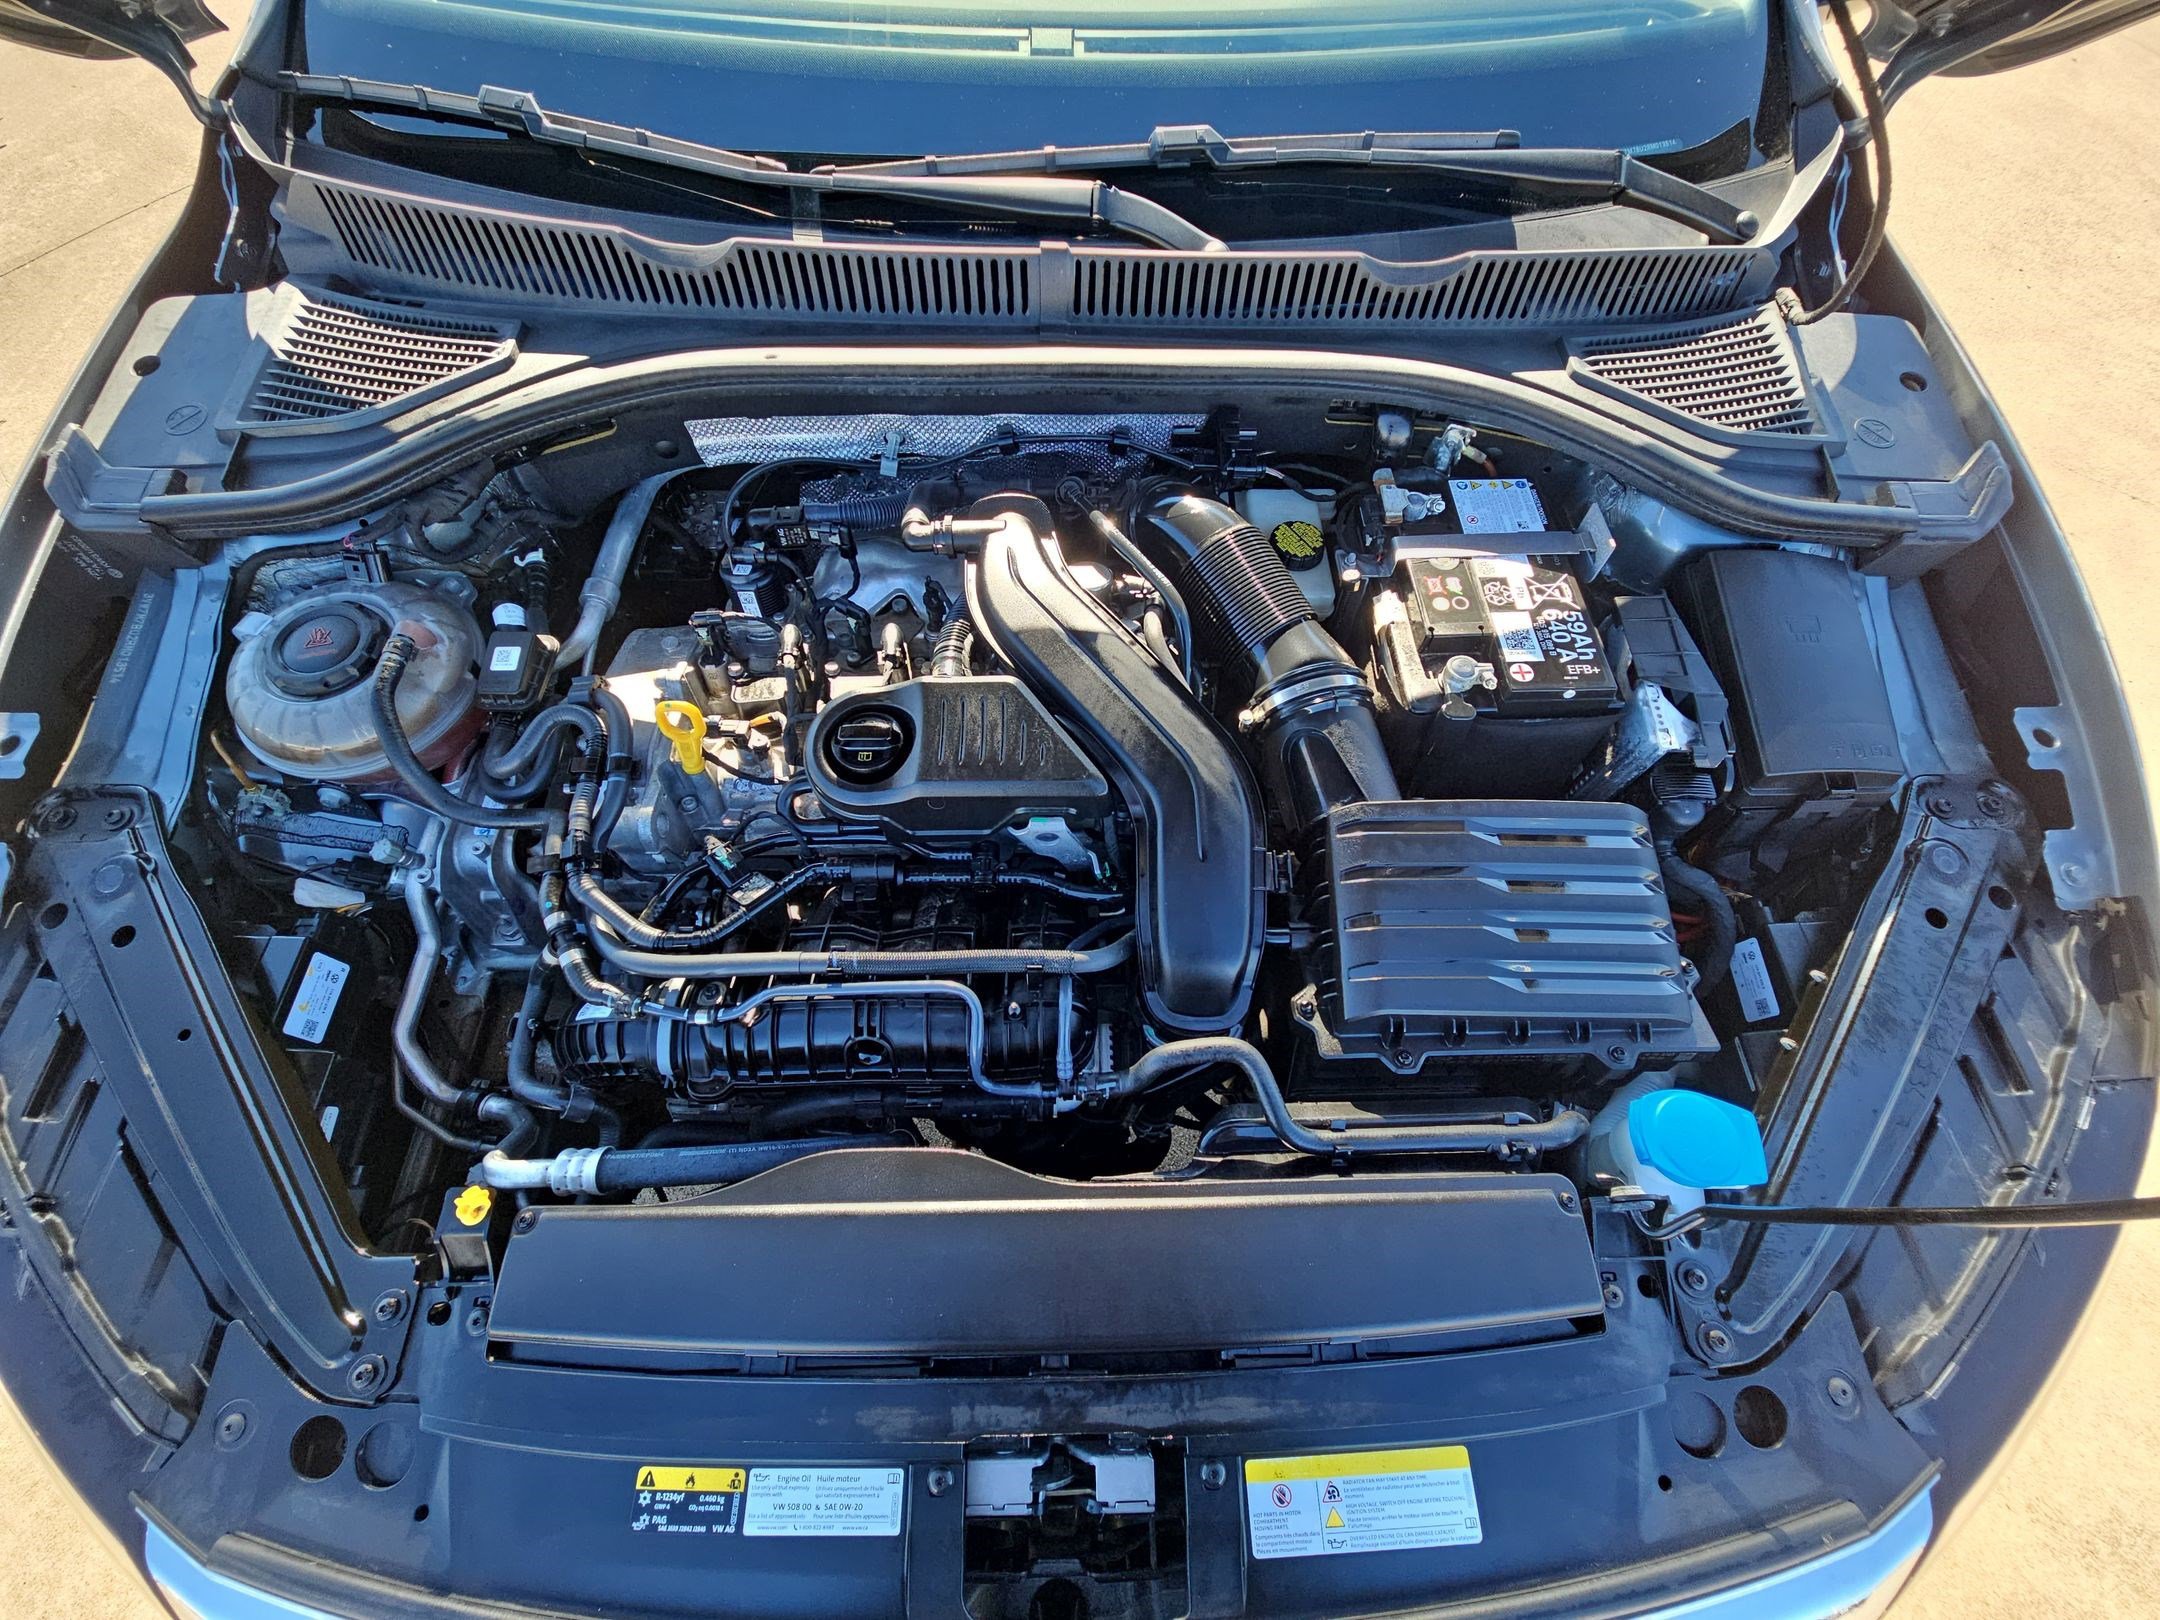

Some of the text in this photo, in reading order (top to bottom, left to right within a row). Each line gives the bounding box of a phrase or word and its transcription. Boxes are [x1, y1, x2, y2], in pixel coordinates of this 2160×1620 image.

[1542, 609, 1571, 643] 640
[1563, 611, 1596, 660] 59Ah
[1556, 648, 1578, 662] A
[1567, 665, 1600, 674] EFB+
[778, 1475, 800, 1484] Engine
[656, 1493, 685, 1503] R-1234yf
[717, 1496, 725, 1504] kg
[652, 1516, 667, 1524] PAG
